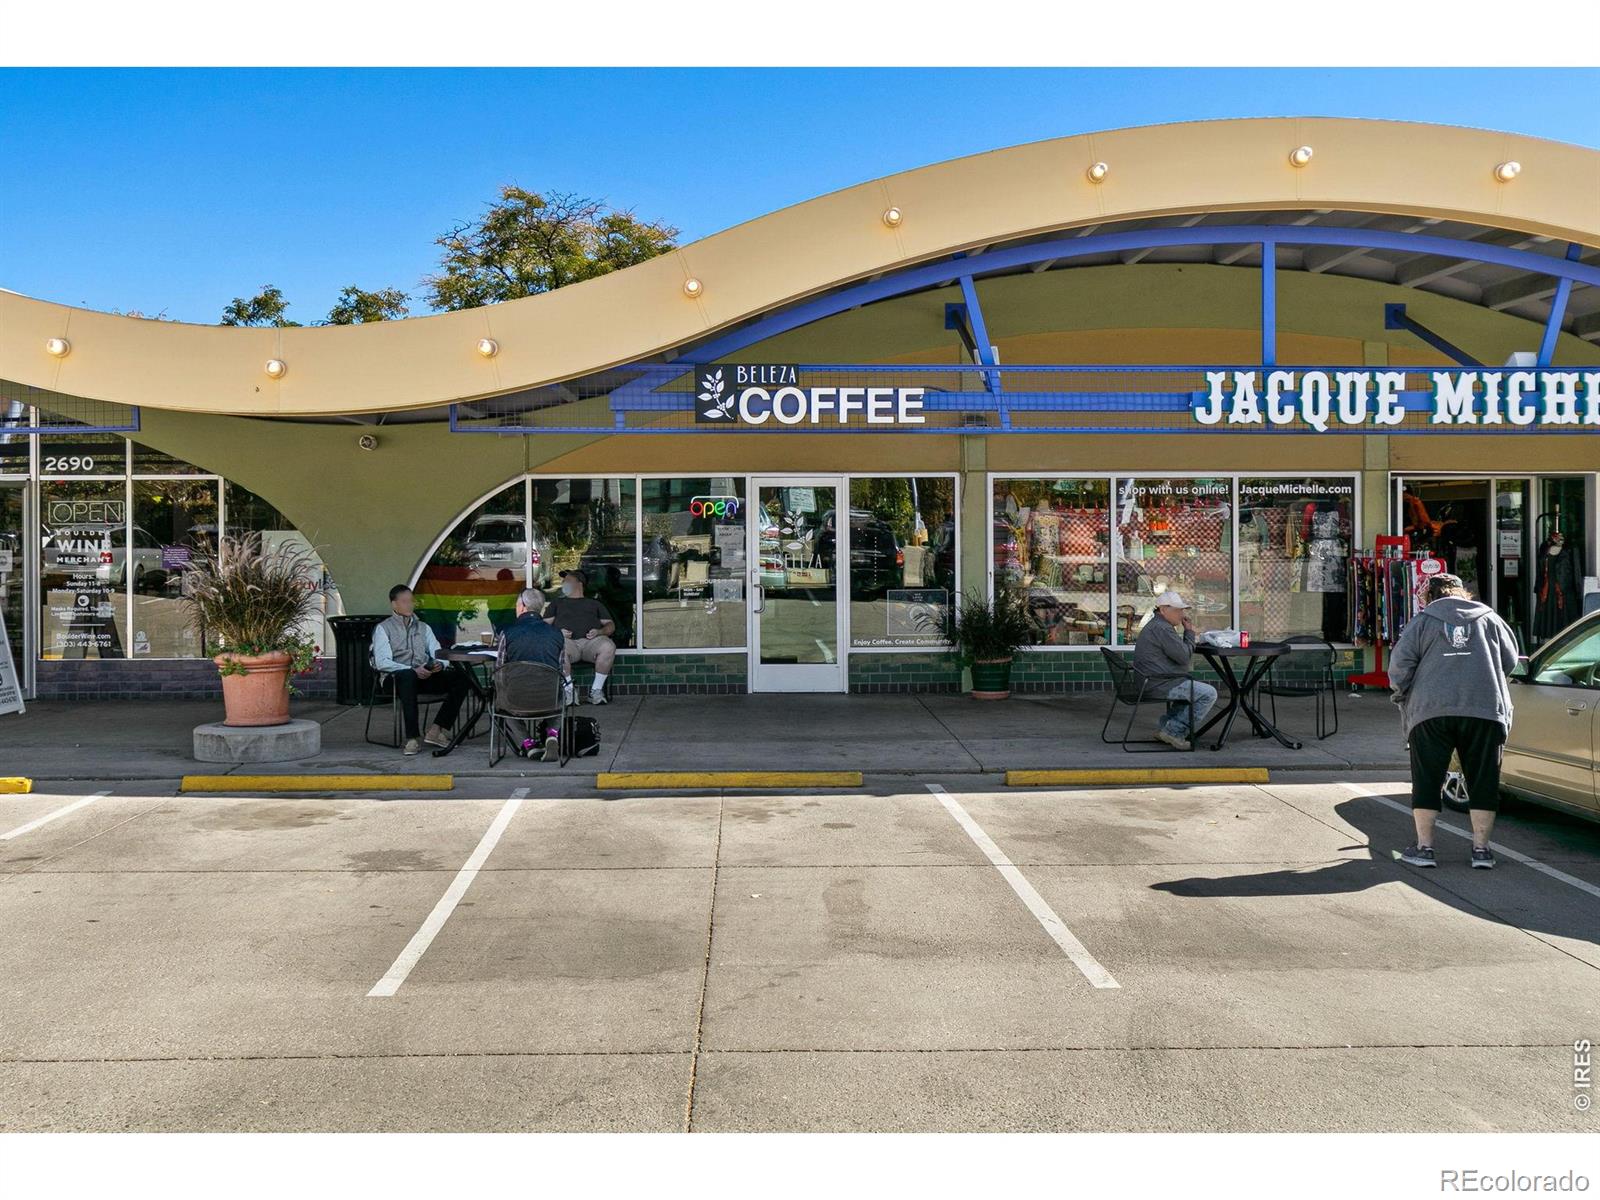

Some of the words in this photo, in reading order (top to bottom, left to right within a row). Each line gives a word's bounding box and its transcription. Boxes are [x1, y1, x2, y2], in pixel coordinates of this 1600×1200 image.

[737, 365, 797, 383] BELEZA
[738, 386, 926, 425] COFFEE
[1194, 371, 1406, 432] JACQUE
[45, 456, 94, 471] 2690
[1118, 484, 1146, 496] shop
[1149, 484, 1173, 495] with
[1175, 486, 1189, 495] us
[1191, 484, 1229, 495] online!
[1239, 484, 1352, 497] JacqueMichelle.com
[53, 503, 121, 522] OPEN
[689, 501, 737, 519] open
[56, 539, 111, 553] WINE
[773, 553, 823, 569] BELEZA
[66, 580, 88, 588] Sunday
[853, 639, 871, 647] Enjoy
